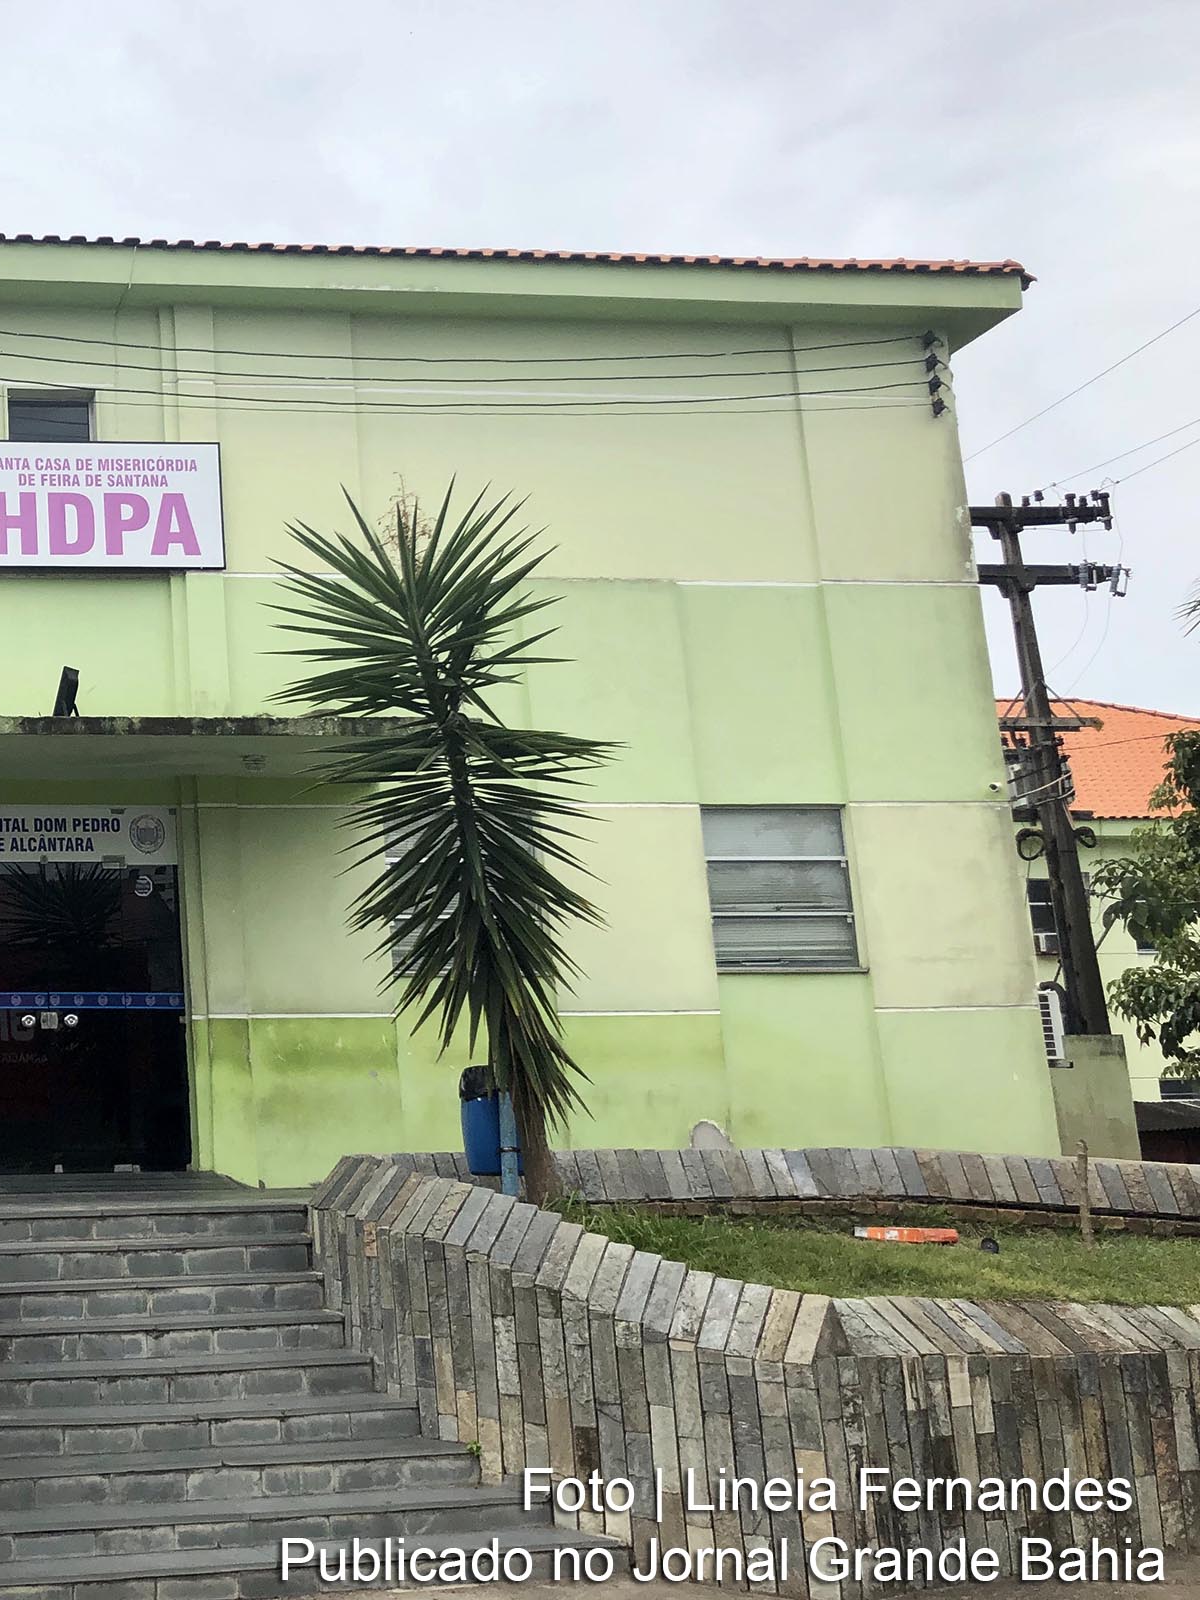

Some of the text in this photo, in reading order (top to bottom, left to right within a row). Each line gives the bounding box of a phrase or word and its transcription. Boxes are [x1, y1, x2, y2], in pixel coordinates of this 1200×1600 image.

[35, 458, 71, 471] CASA
[76, 458, 93, 471] DE
[99, 456, 198, 472] MISERICÓRDIA
[18, 474, 168, 487] DE FEIRA DE SANTANA
[33, 818, 67, 833] DOM
[73, 818, 121, 833] PEDRO
[10, 833, 94, 852] ALCÂNTARA
